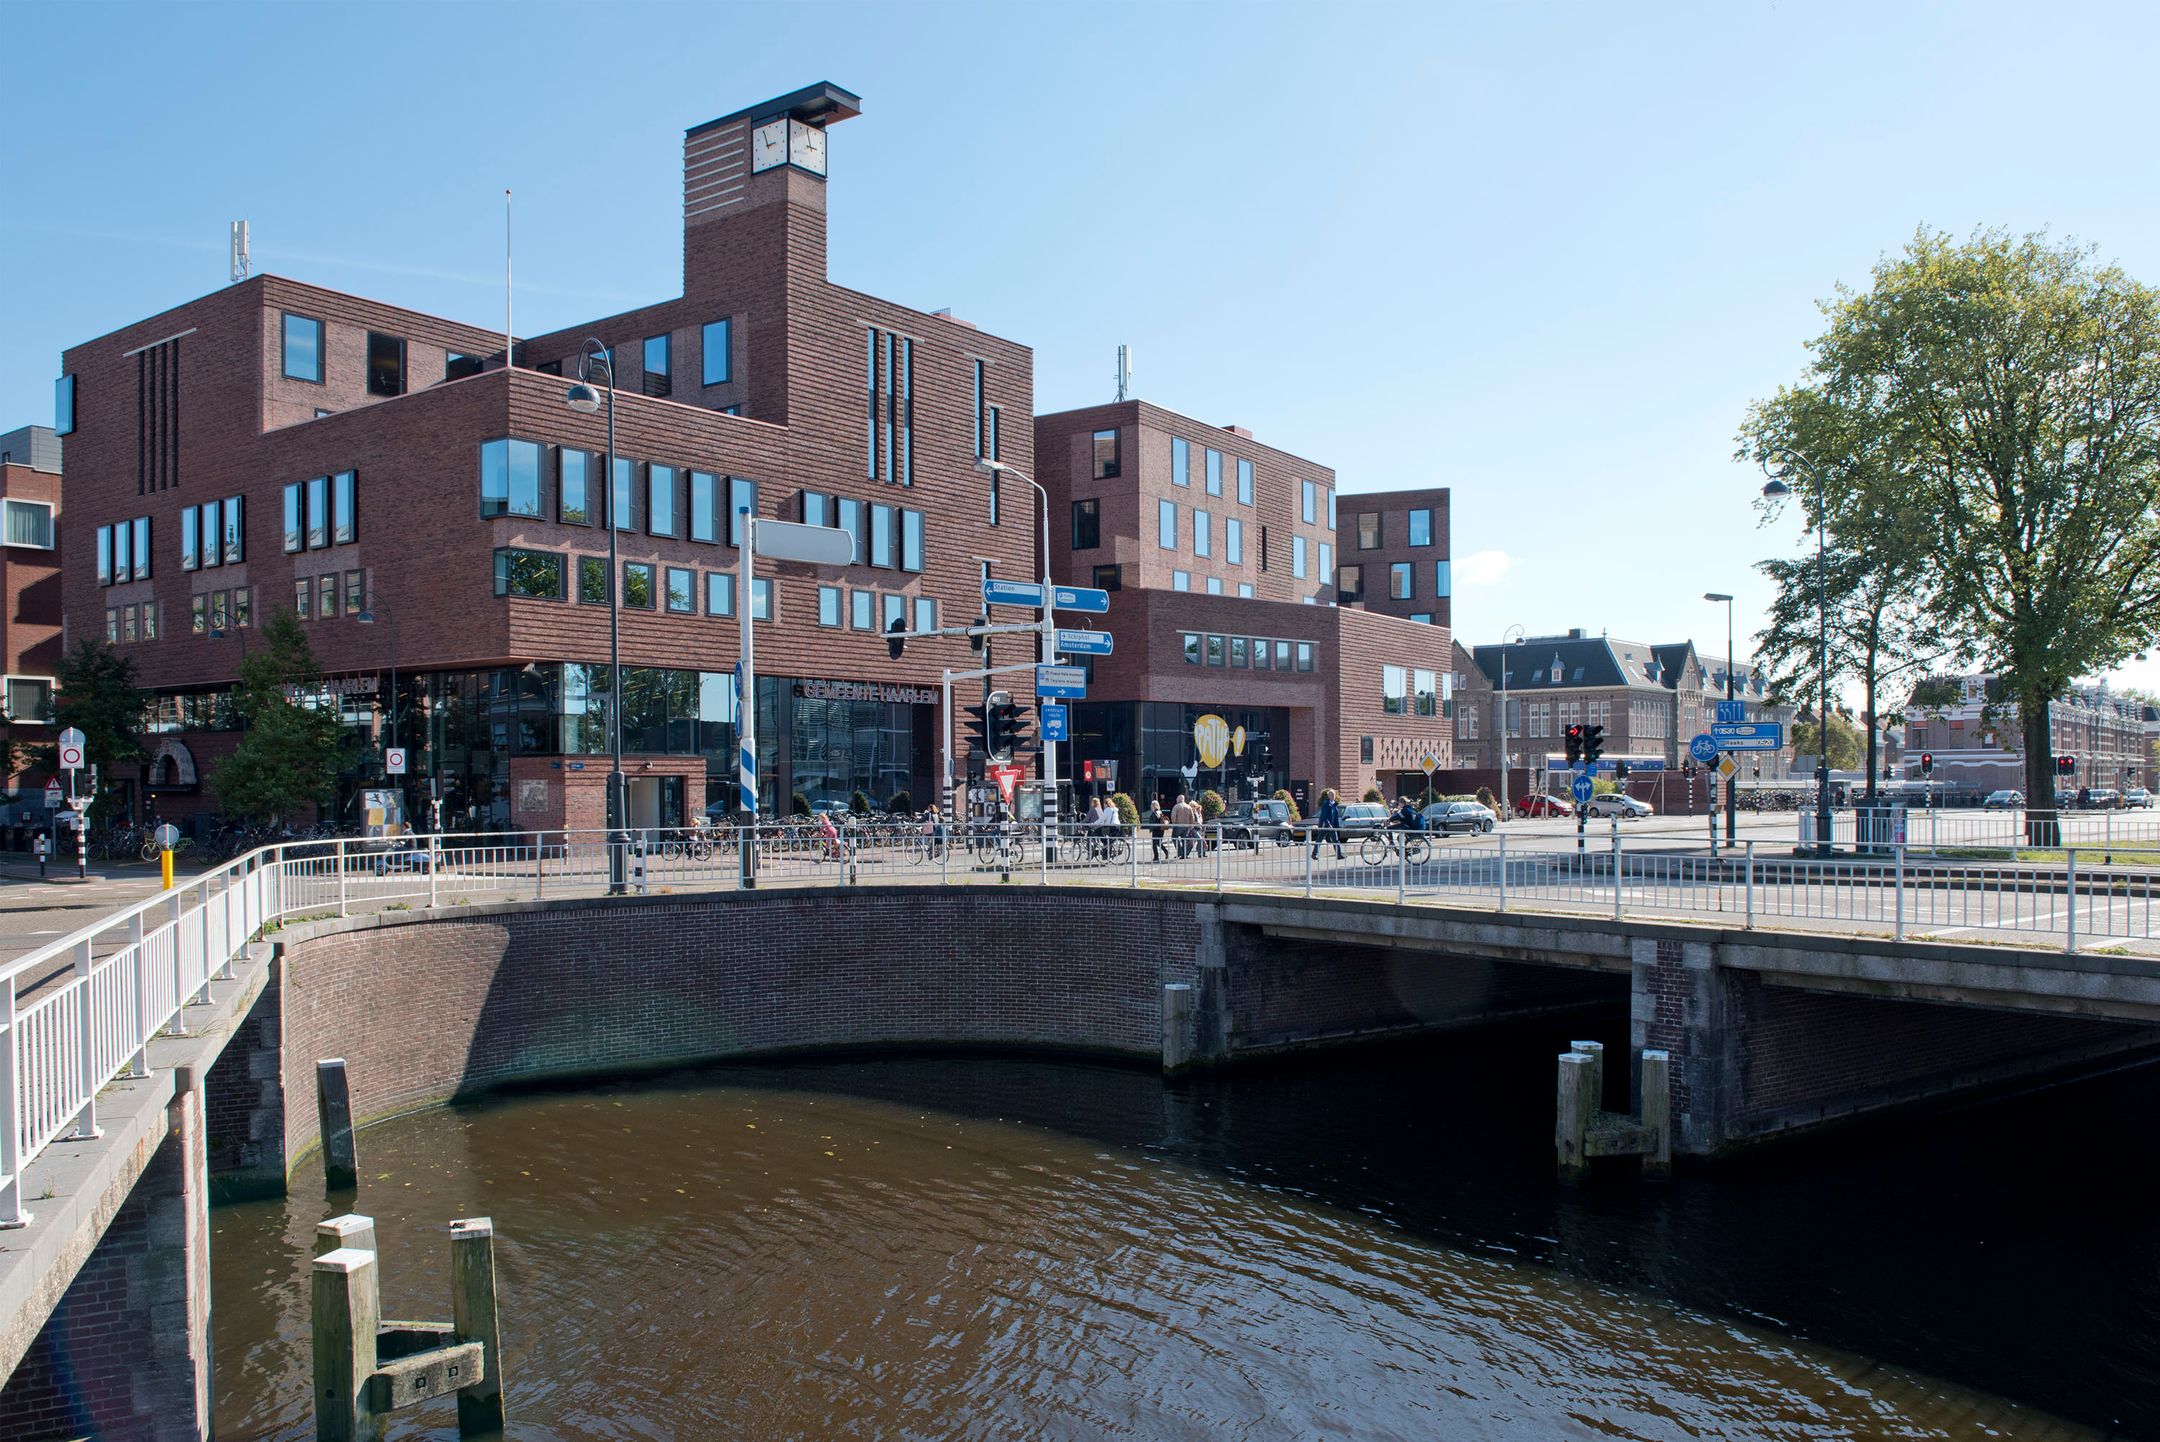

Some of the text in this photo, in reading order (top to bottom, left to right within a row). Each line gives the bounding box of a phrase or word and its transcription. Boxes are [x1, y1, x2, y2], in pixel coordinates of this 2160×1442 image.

[994, 584, 1015, 592] Station
[805, 682, 939, 705] GEMEENTE HAARLEM
